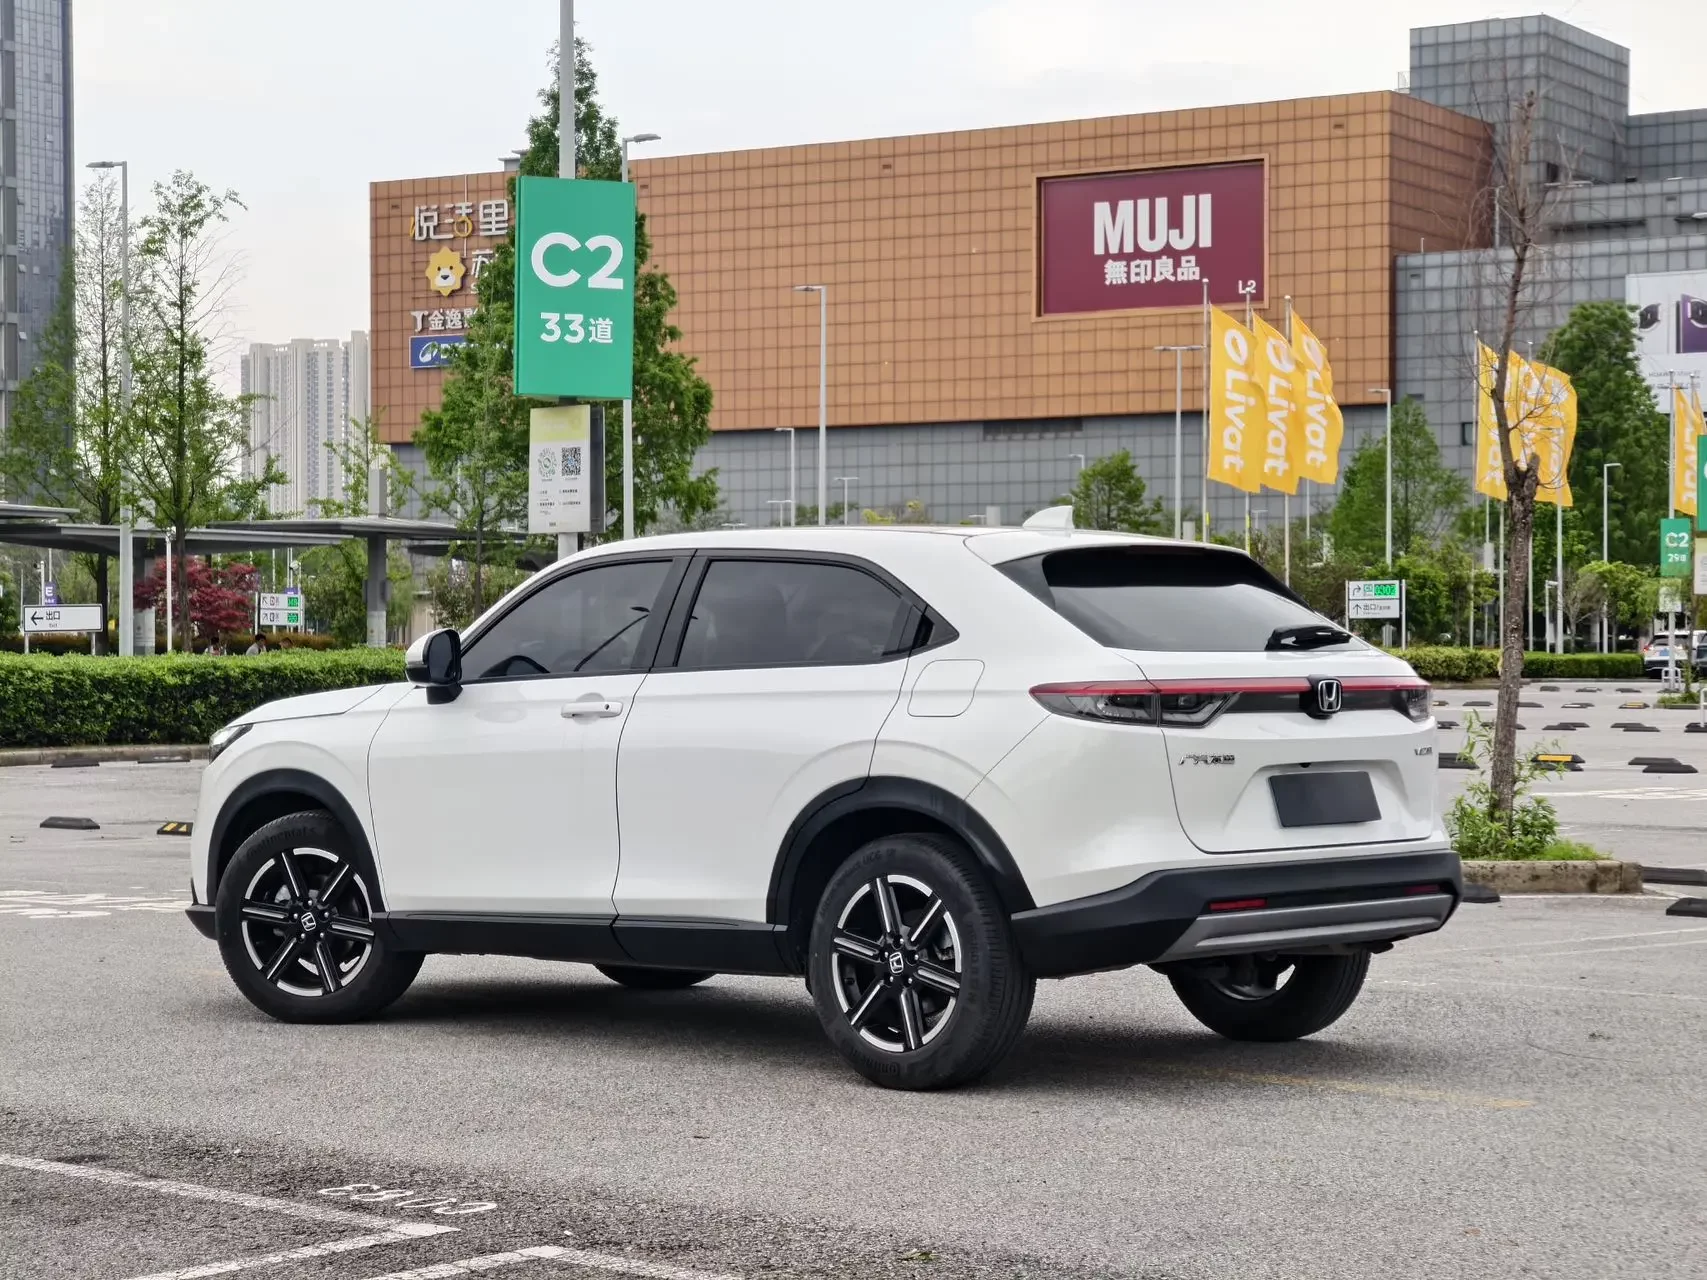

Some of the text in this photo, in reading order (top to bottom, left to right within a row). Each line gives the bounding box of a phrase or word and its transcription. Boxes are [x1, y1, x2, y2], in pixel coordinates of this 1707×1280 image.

[1094, 194, 1212, 255] MUJI
[531, 232, 624, 290] C2
[1104, 256, 1200, 285] 無印良品
[1238, 279, 1256, 294] L2
[540, 312, 613, 343] 33道
[1665, 532, 1688, 547] C2
[45, 610, 61, 621] 出口
